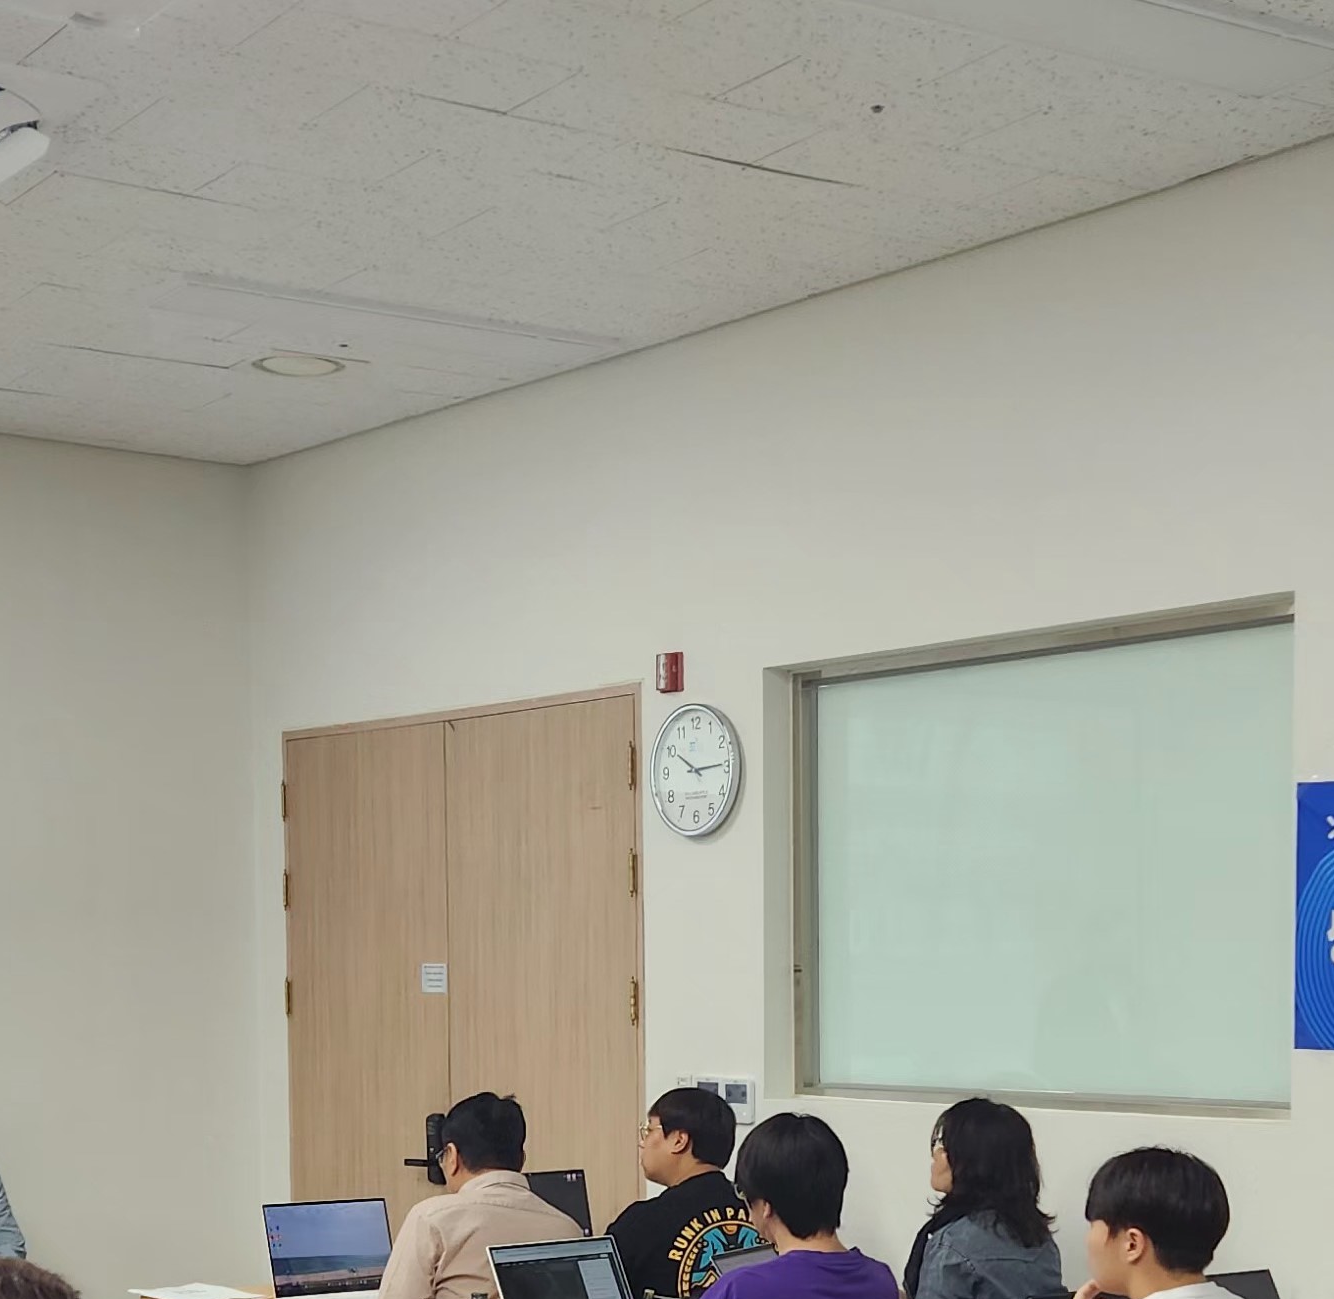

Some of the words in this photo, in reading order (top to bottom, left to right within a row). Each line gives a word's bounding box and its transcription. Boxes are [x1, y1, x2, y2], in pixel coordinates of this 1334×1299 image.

[691, 716, 701, 730] 12
[677, 726, 686, 739] 11
[718, 735, 725, 749] 2
[667, 744, 677, 758] 10
[662, 767, 670, 780] 9
[723, 760, 730, 773] 3
[667, 790, 675, 803] 8
[718, 784, 726, 798] 4
[679, 805, 685, 819] 7
[708, 803, 715, 816] 5
[693, 810, 700, 824] 6
[703, 1208, 721, 1224] IN
[725, 1207, 747, 1221] PA
